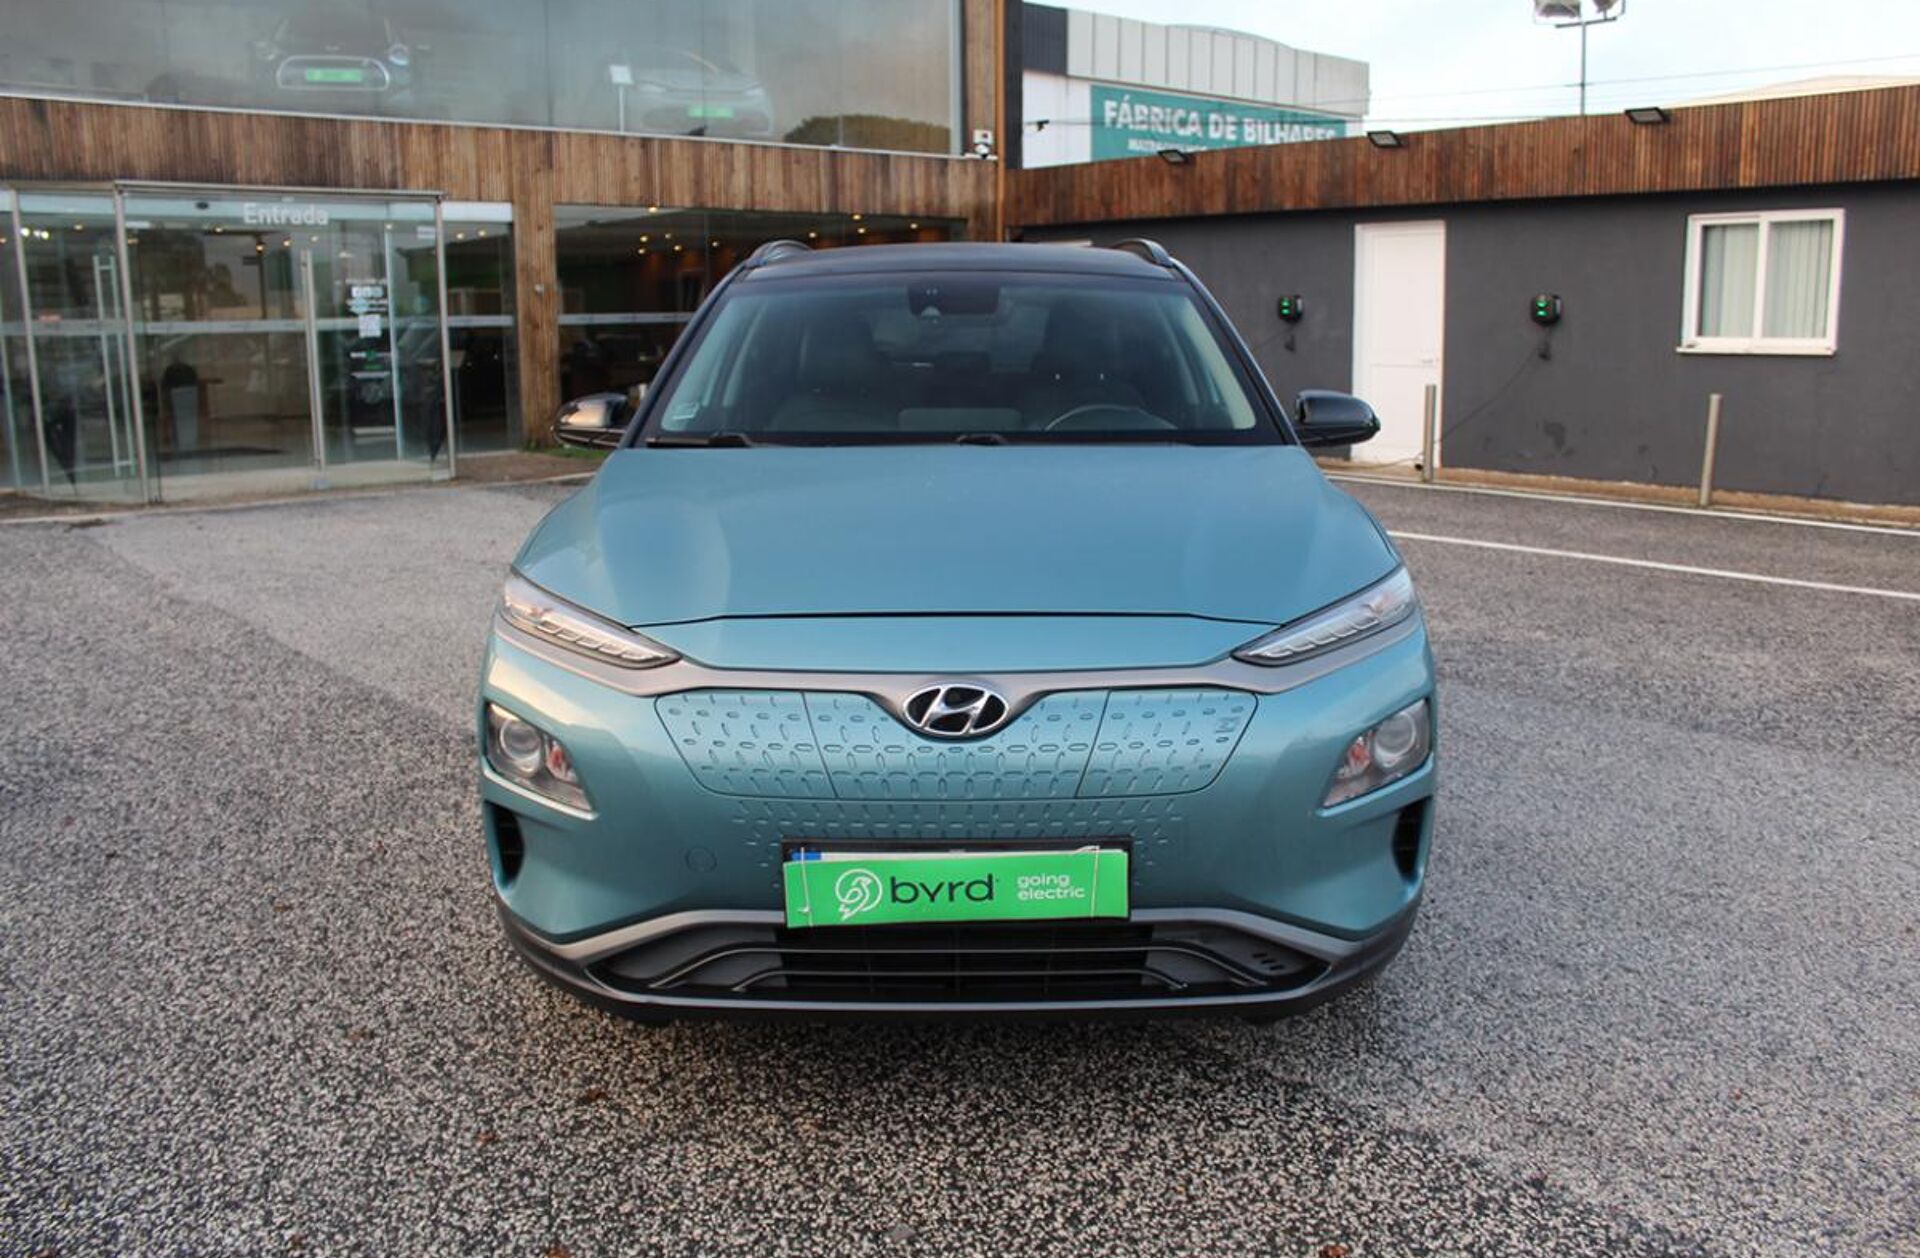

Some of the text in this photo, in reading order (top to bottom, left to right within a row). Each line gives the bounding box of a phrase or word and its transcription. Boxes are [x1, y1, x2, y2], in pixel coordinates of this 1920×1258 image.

[1103, 95, 1203, 138] FÁBRICA
[1208, 113, 1238, 140] DE
[243, 202, 329, 225] Entrada
[890, 873, 993, 903] byrd
[1017, 872, 1070, 888] going
[1017, 886, 1085, 900] electric
